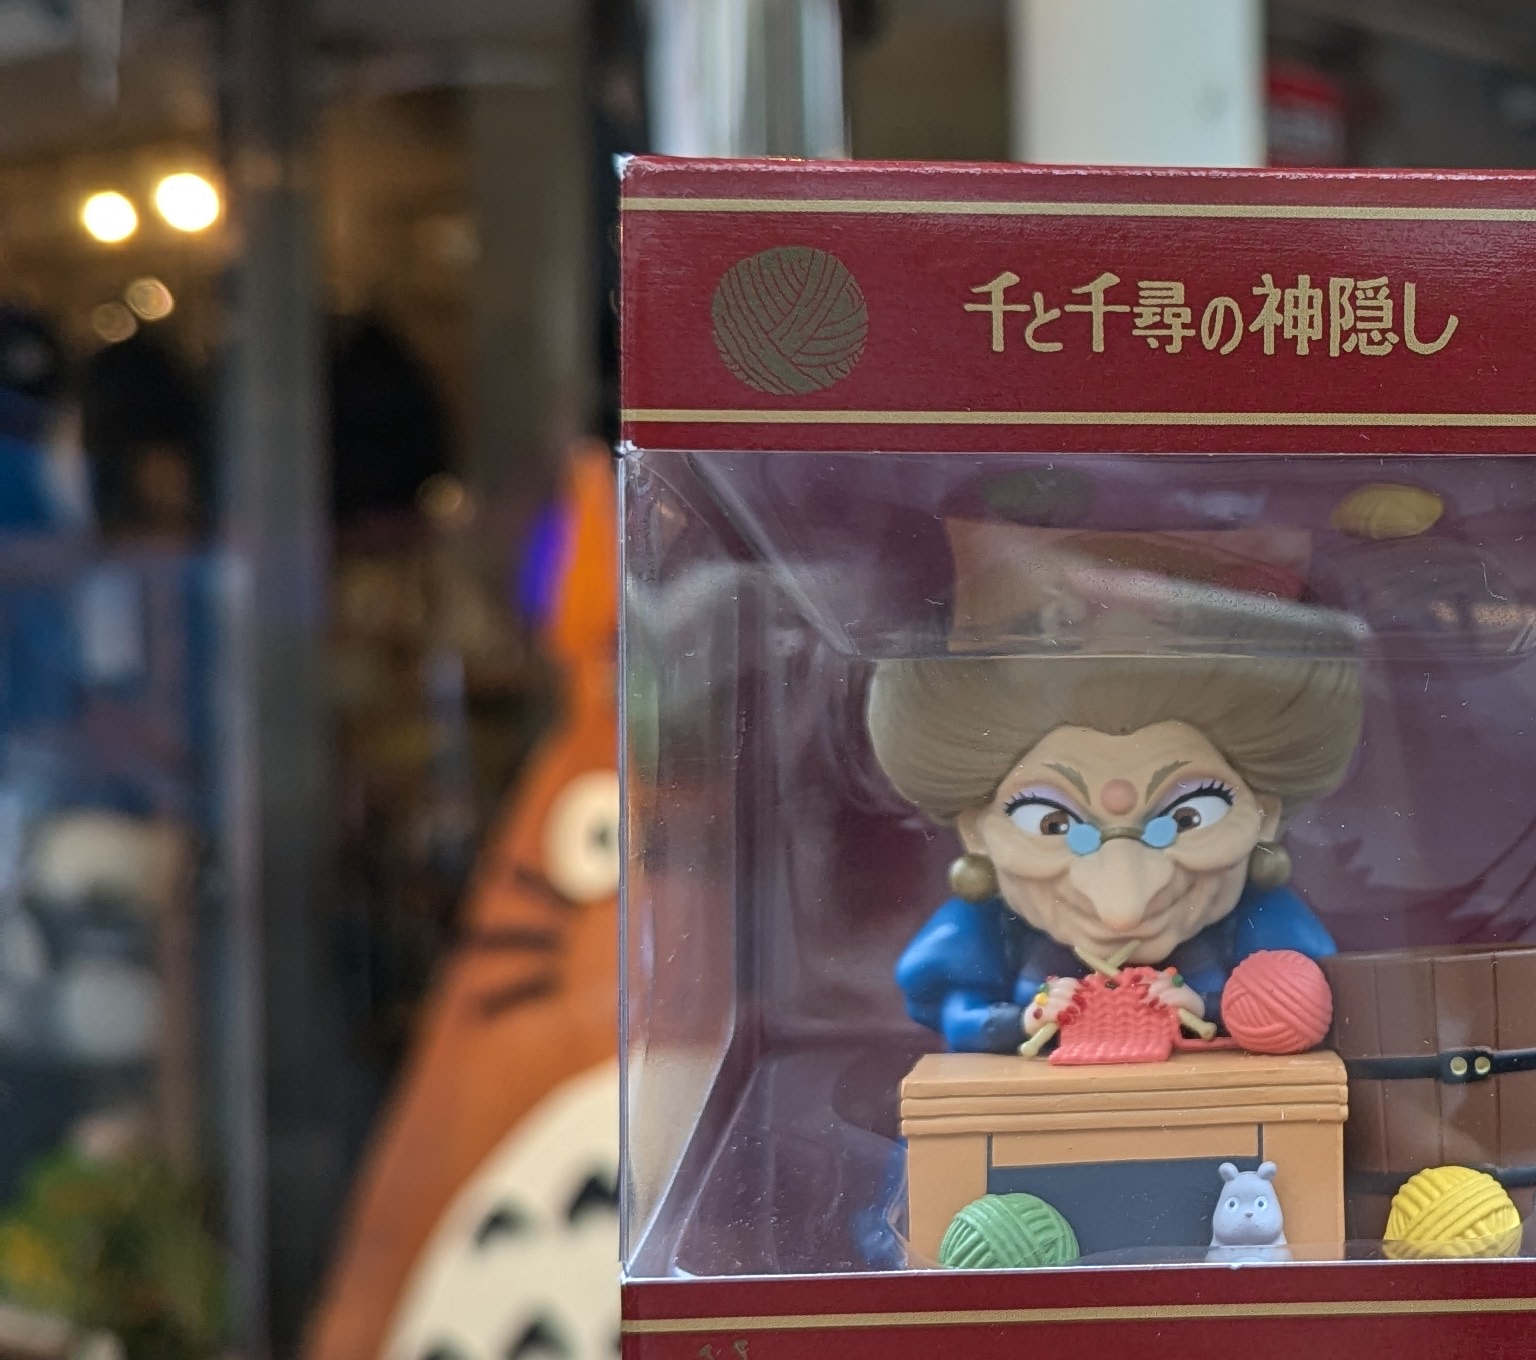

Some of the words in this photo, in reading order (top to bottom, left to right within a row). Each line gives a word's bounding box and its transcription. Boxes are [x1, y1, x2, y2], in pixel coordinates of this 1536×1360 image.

[963, 270, 1460, 358] 千と千尋の神隠し
